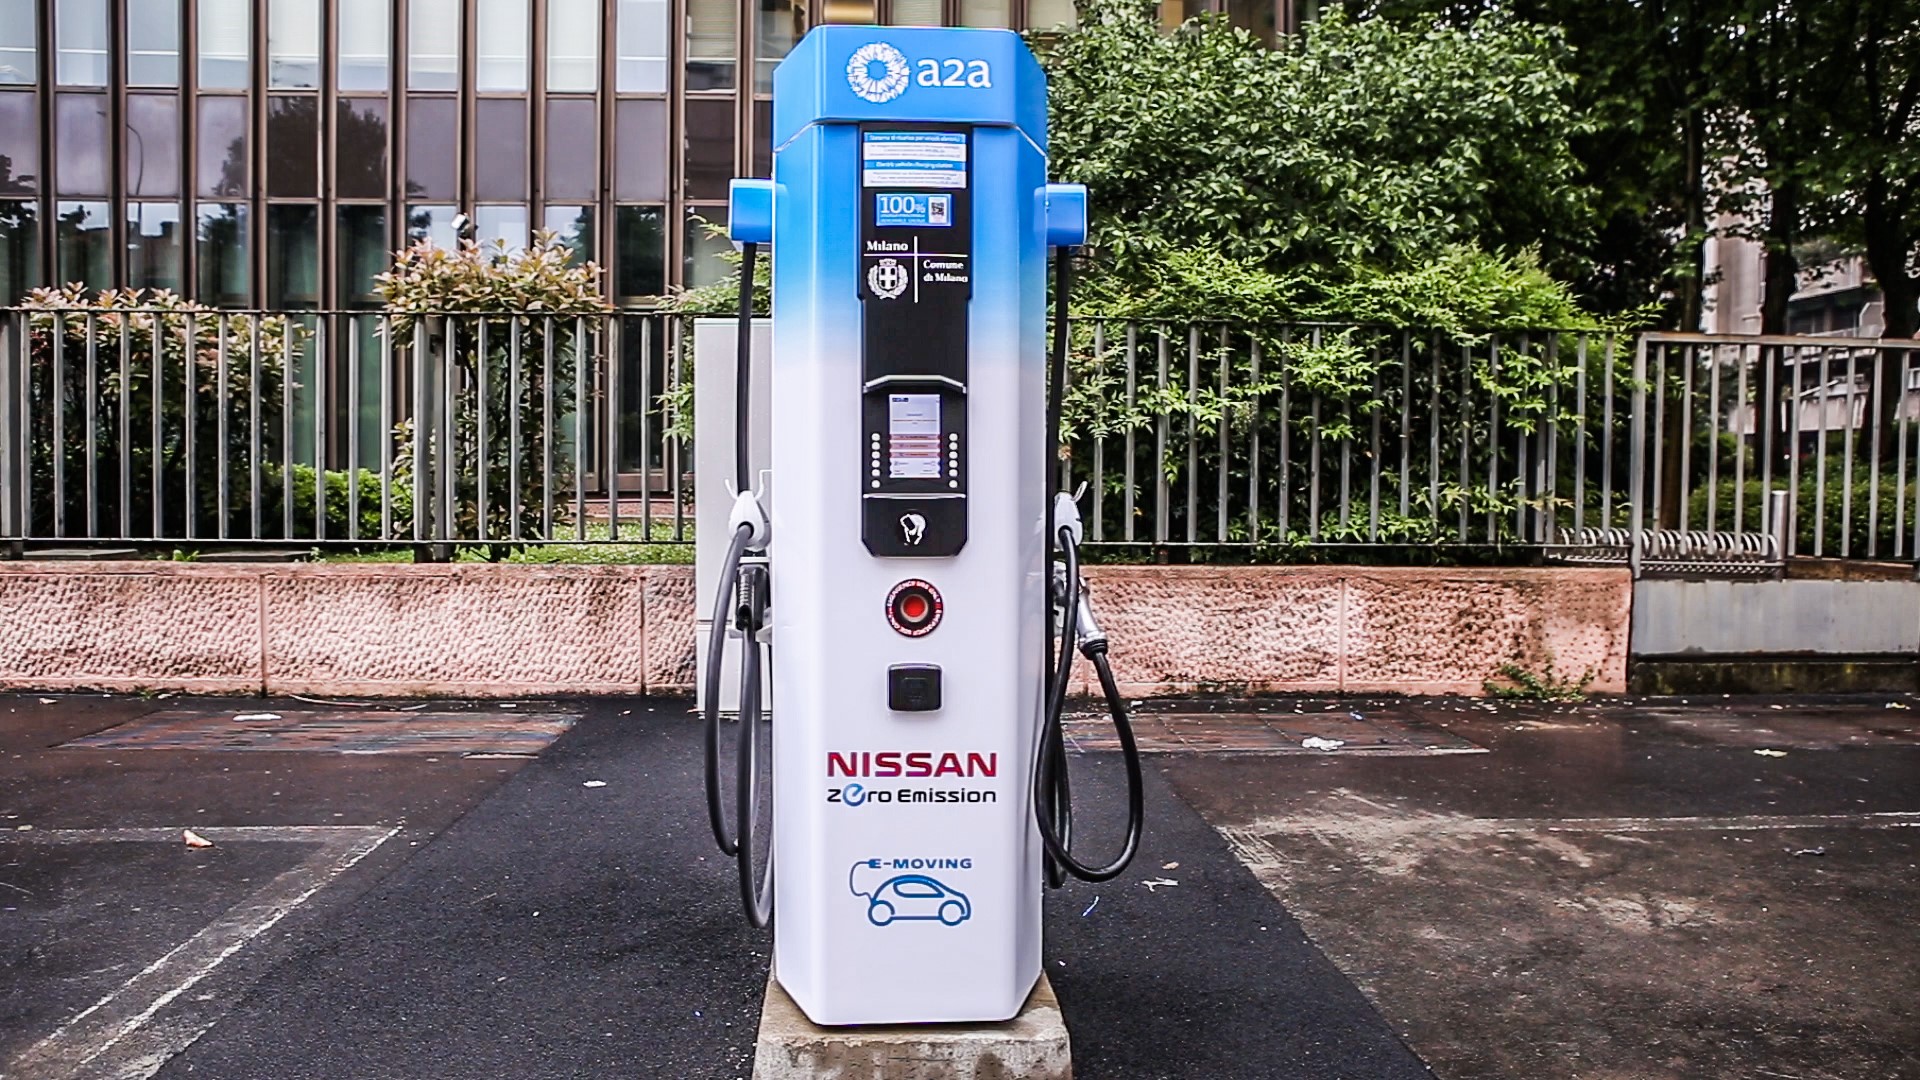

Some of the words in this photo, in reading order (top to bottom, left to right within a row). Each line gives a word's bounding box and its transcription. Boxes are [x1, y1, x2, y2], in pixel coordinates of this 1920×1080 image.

[916, 58, 992, 88] a2a
[880, 196, 926, 214] 100%
[866, 240, 909, 251] Milano
[923, 259, 964, 269] Comune
[923, 272, 933, 282] di
[935, 272, 968, 283] Milano
[827, 752, 997, 778] NISSAN
[897, 788, 997, 803] Emission
[869, 858, 972, 869] E-MOVING
